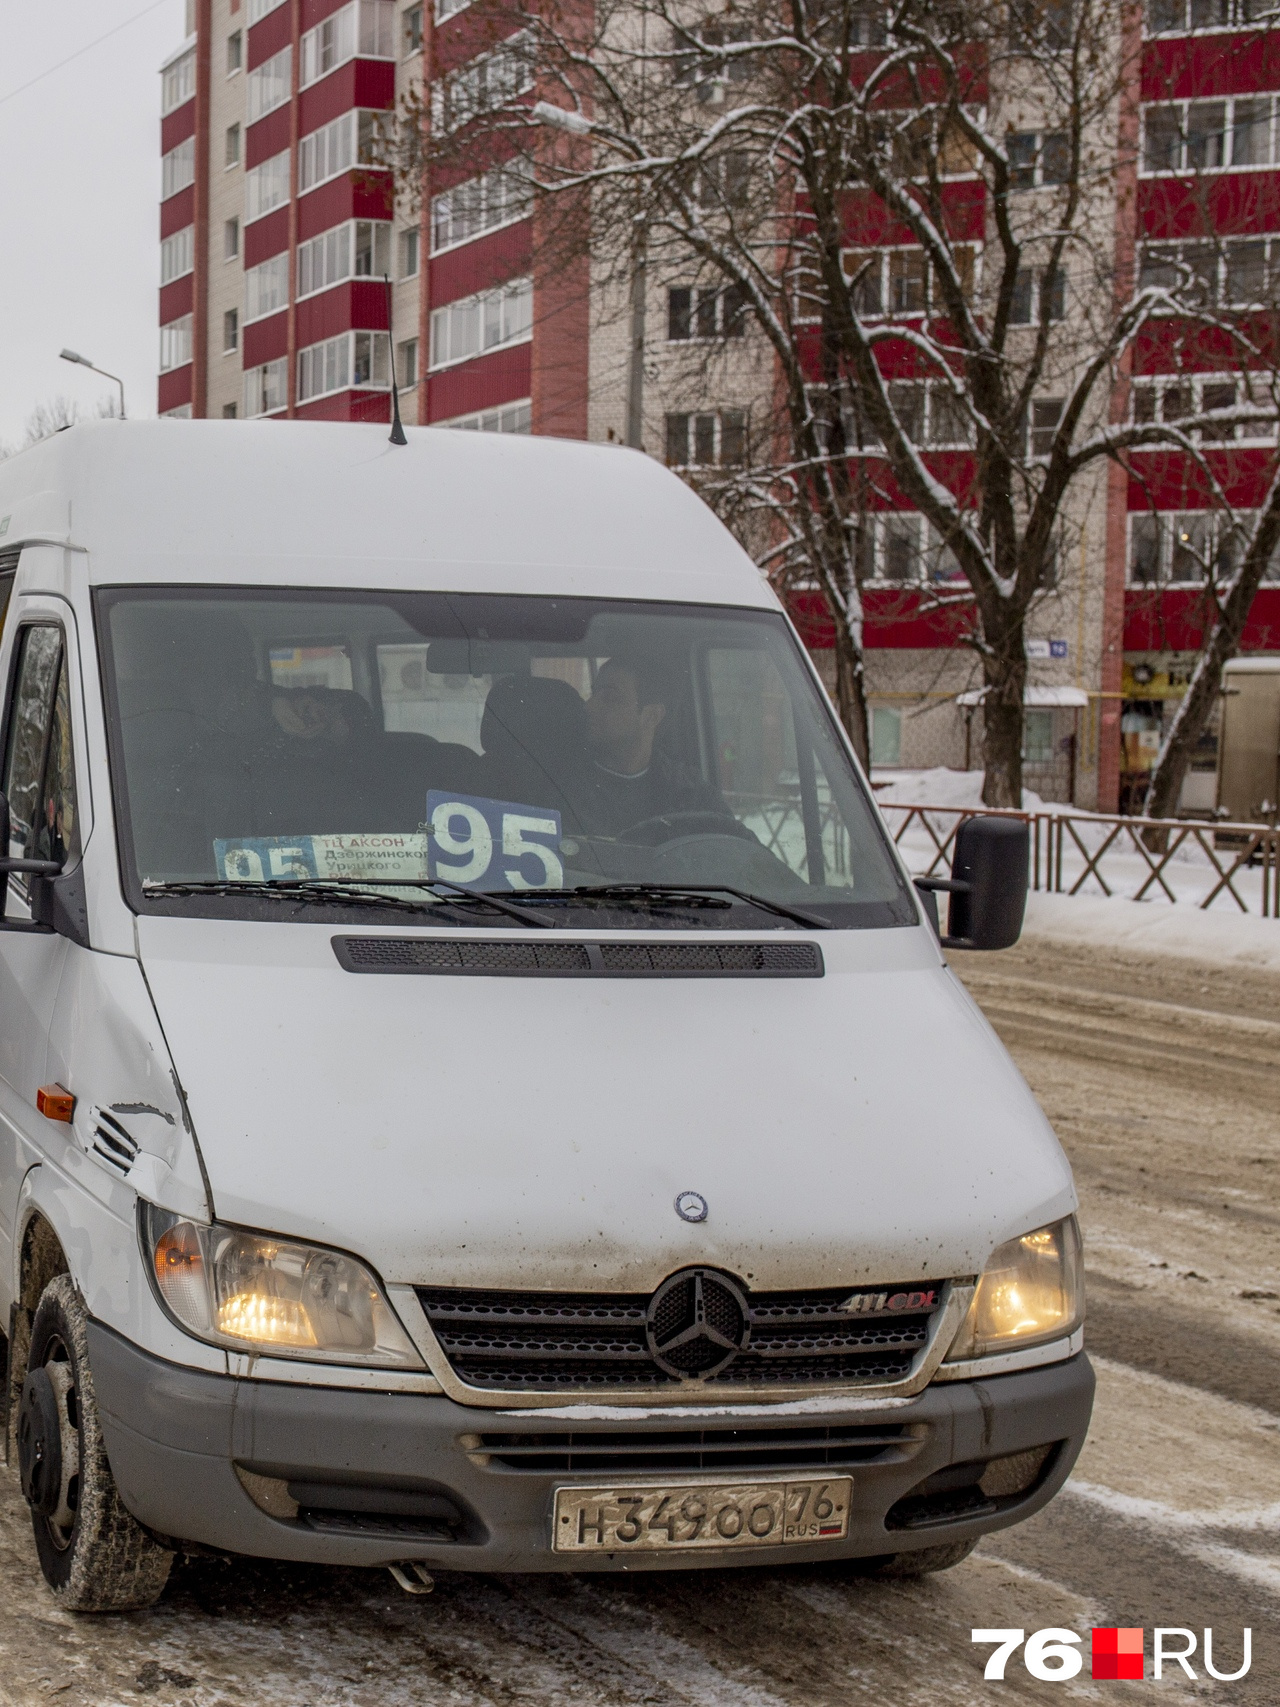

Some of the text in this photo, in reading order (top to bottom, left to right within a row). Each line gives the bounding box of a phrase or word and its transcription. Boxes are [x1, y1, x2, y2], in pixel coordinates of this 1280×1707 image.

[323, 838, 405, 849] ТЦ АКСОН
[431, 802, 563, 890] 95
[325, 850, 428, 860] Дзержинског
[326, 861, 401, 872] Урицкого
[791, 1485, 833, 1522] 76
[785, 1523, 819, 1538] RUS
